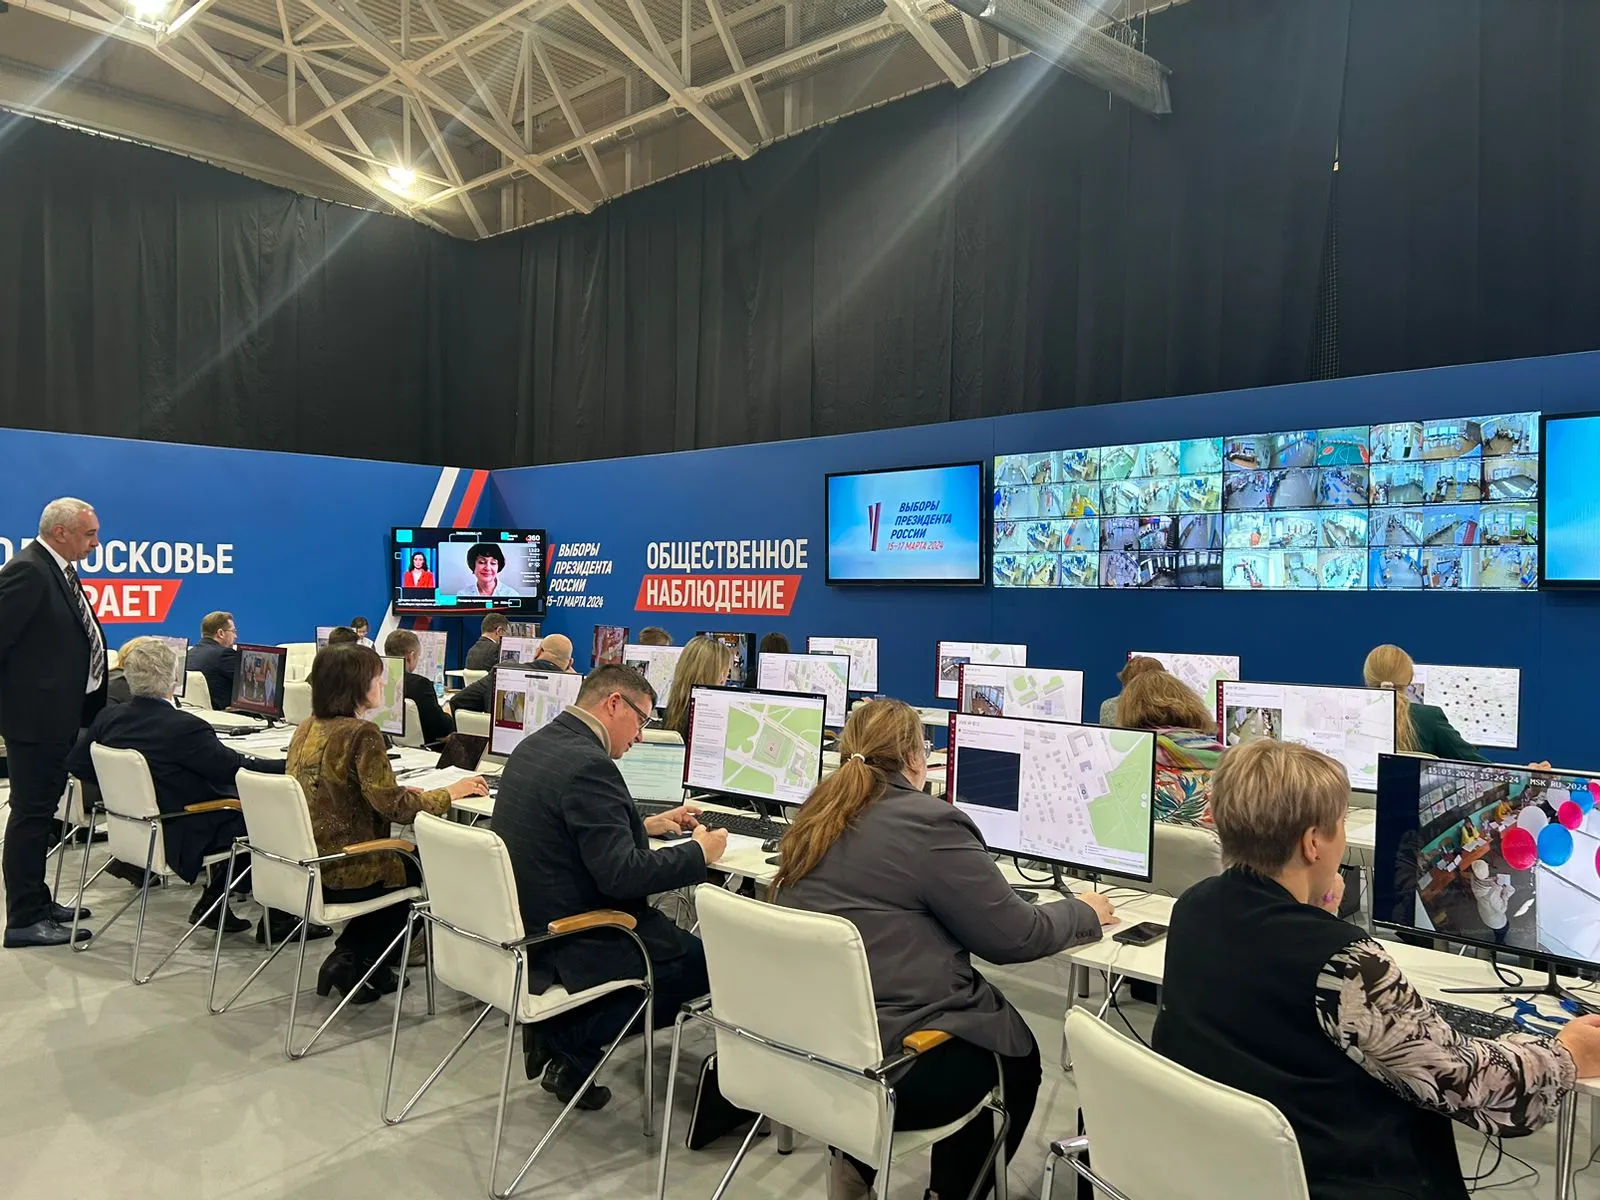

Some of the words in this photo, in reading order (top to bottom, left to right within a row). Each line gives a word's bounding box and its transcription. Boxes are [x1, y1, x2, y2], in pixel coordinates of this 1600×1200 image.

[899, 500, 940, 512] ВЫБОРЫ
[895, 513, 952, 526] ПРЕЗИДЕНТА
[890, 528, 927, 540] РОССИИ
[558, 542, 601, 557] ВЫБОРЫ
[905, 541, 927, 551] МАРТА
[927, 541, 944, 550] 2024
[0, 536, 234, 575] ООСКОВЬЕ
[646, 538, 808, 573] ОБЩЕСТВЕННОЕ
[553, 560, 613, 576] ПРЕЗИДЕНТА
[549, 578, 587, 592] РОССИИ
[646, 577, 785, 612] НАБЛЮДЕНИЕ
[563, 595, 587, 608] МАРТА
[586, 595, 604, 608] 2024
[1529, 778, 1547, 787] MSK
[1550, 780, 1562, 788] RU
[1566, 783, 1588, 791] 2024
